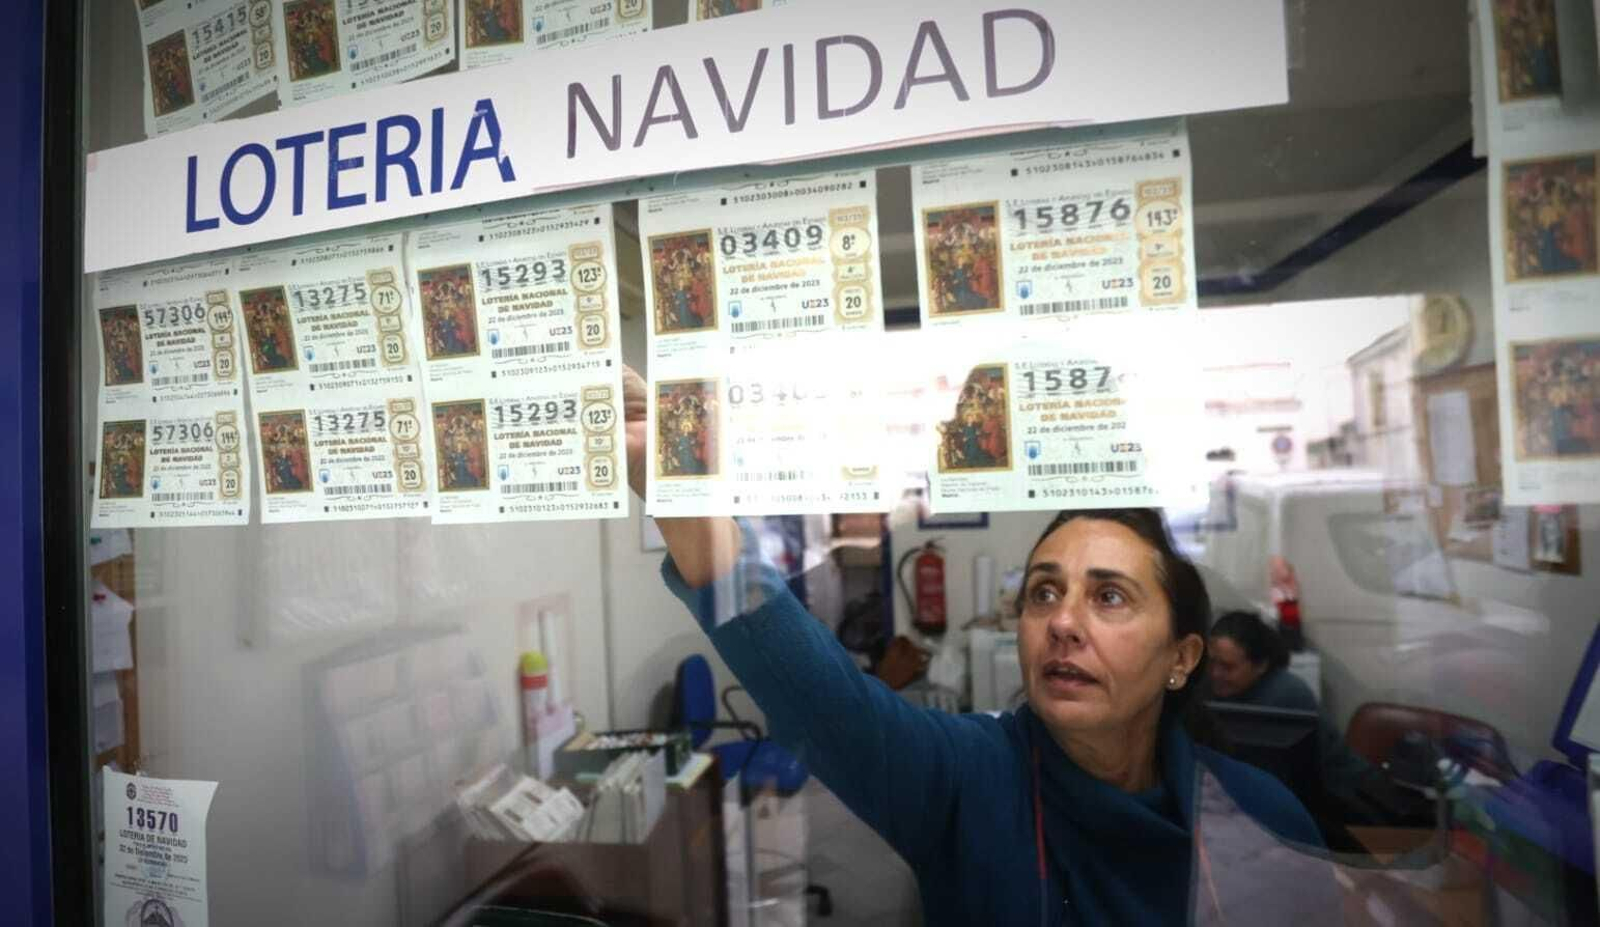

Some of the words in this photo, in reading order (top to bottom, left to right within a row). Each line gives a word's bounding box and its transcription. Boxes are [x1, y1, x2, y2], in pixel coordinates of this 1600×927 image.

[192, 5, 247, 44] 15415
[357, 22, 367, 30] DE
[369, 10, 405, 26] NAVIDAD
[430, 21, 441, 34] 20
[259, 50, 269, 62] 20
[186, 98, 515, 234] LOTERIA
[568, 8, 1056, 158] NAVIDAD
[1014, 198, 1131, 230] 15876
[720, 224, 823, 256] 03409
[1032, 252, 1046, 260] DE
[1018, 265, 1028, 274] 22
[1031, 264, 1042, 272] de
[1044, 260, 1086, 271] diciembre
[1088, 259, 1099, 267] de
[1102, 257, 1123, 266] 2023
[481, 259, 566, 287] 15293
[741, 275, 755, 283] DE
[730, 287, 739, 296] 22
[741, 286, 750, 294] de
[752, 283, 788, 293] diciembre
[790, 281, 799, 289] de
[802, 279, 821, 288] 2023
[1153, 275, 1171, 289] 20
[294, 281, 367, 308] 13275
[521, 288, 568, 300] NACIONAL
[498, 304, 509, 313] DE
[512, 300, 553, 311] NAVIDAD
[846, 296, 862, 309] 20
[144, 303, 206, 327] 57306
[507, 311, 537, 321] diciembre
[538, 310, 547, 318] de
[311, 323, 322, 332] DE
[323, 320, 358, 330] NAVIDAD
[586, 324, 600, 336] 20
[387, 343, 399, 354] 20
[219, 358, 230, 369] 20
[1023, 366, 1124, 392] 1587
[494, 399, 577, 423] 15293
[1040, 413, 1056, 422] DE
[1061, 409, 1116, 421] NAVIDAD
[314, 411, 386, 432] 13275
[152, 422, 214, 442] 57306
[532, 427, 578, 437] NACIONAL
[1027, 426, 1037, 435] 22
[1040, 425, 1050, 433] de
[1053, 423, 1095, 433] diciembre
[1097, 423, 1107, 431] de
[1111, 422, 1127, 430] 202
[340, 446, 375, 454] NAVIDAD
[509, 441, 520, 449] DE
[522, 438, 563, 447] NAVIDAD
[172, 455, 203, 463] NAVIDAD
[517, 450, 547, 458] diciembre
[404, 470, 417, 481] 20
[594, 465, 608, 477] 20
[225, 479, 236, 489] 20
[127, 806, 179, 833] 13570
[146, 833, 155, 843] DE
[157, 835, 187, 849] NAVIDAD
